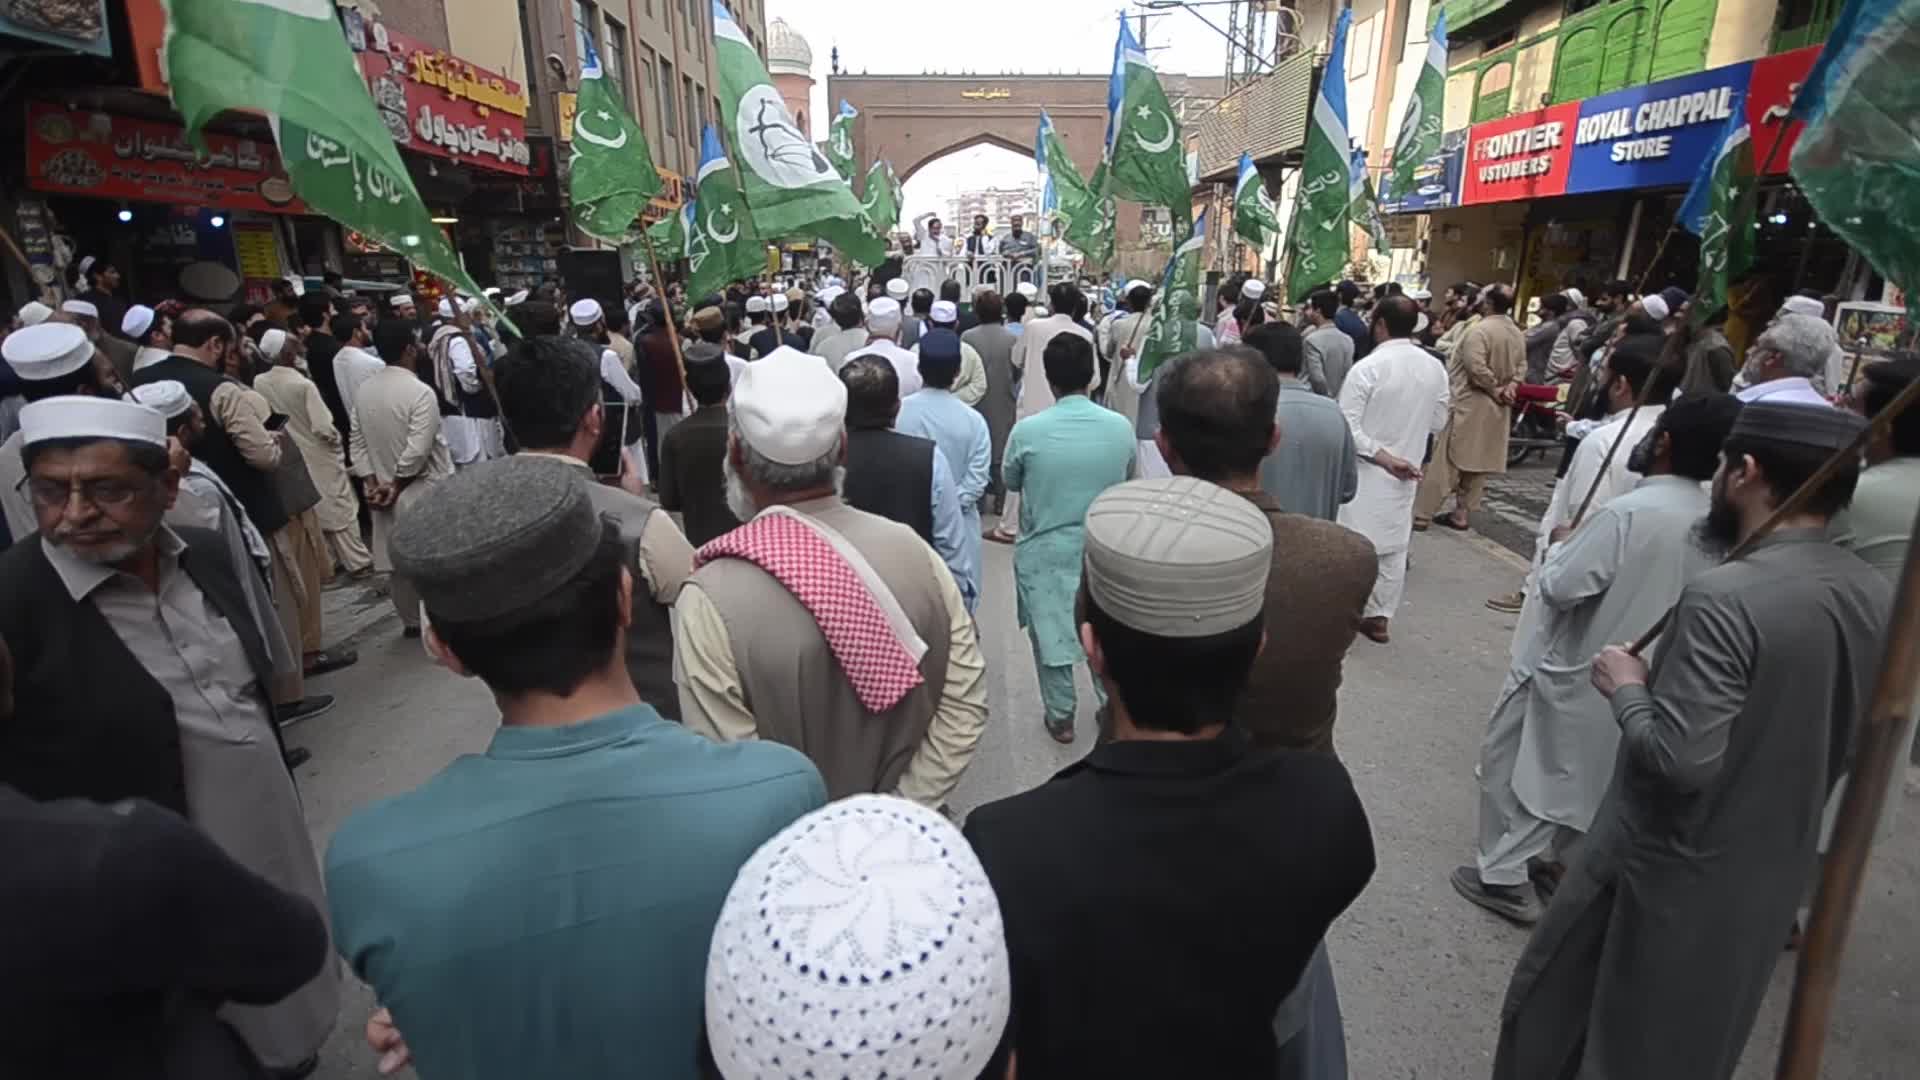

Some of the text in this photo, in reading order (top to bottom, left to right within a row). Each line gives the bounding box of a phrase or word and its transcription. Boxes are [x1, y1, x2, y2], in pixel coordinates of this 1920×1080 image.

[1575, 107, 1633, 145] ROYAL
[1635, 86, 1733, 133] CHAPPAL
[1610, 135, 1673, 162] STORE
